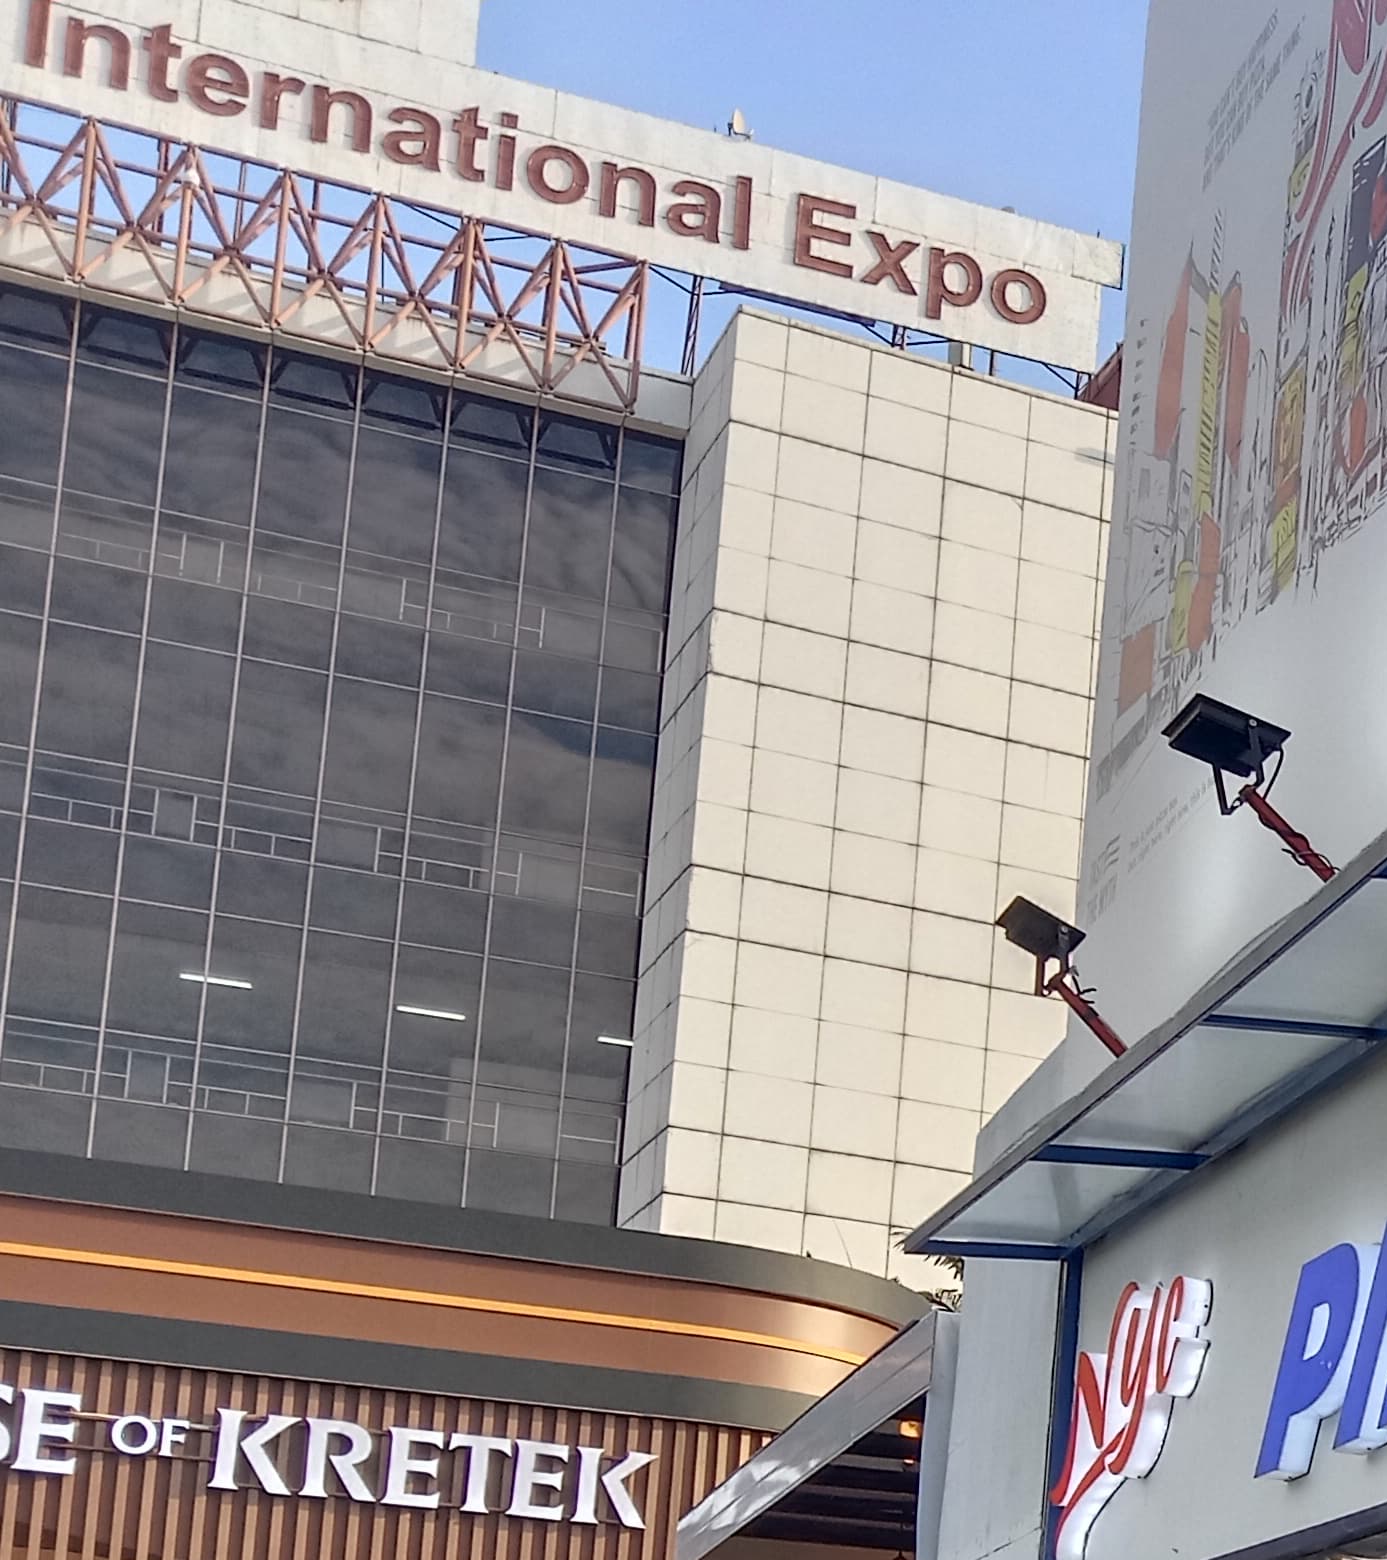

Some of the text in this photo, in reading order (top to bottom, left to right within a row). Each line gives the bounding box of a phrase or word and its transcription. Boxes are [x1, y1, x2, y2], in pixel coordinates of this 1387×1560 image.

[24, 0, 1049, 326] International Expo
[111, 1415, 191, 1457] OF
[207, 1407, 659, 1530] KRETEK
